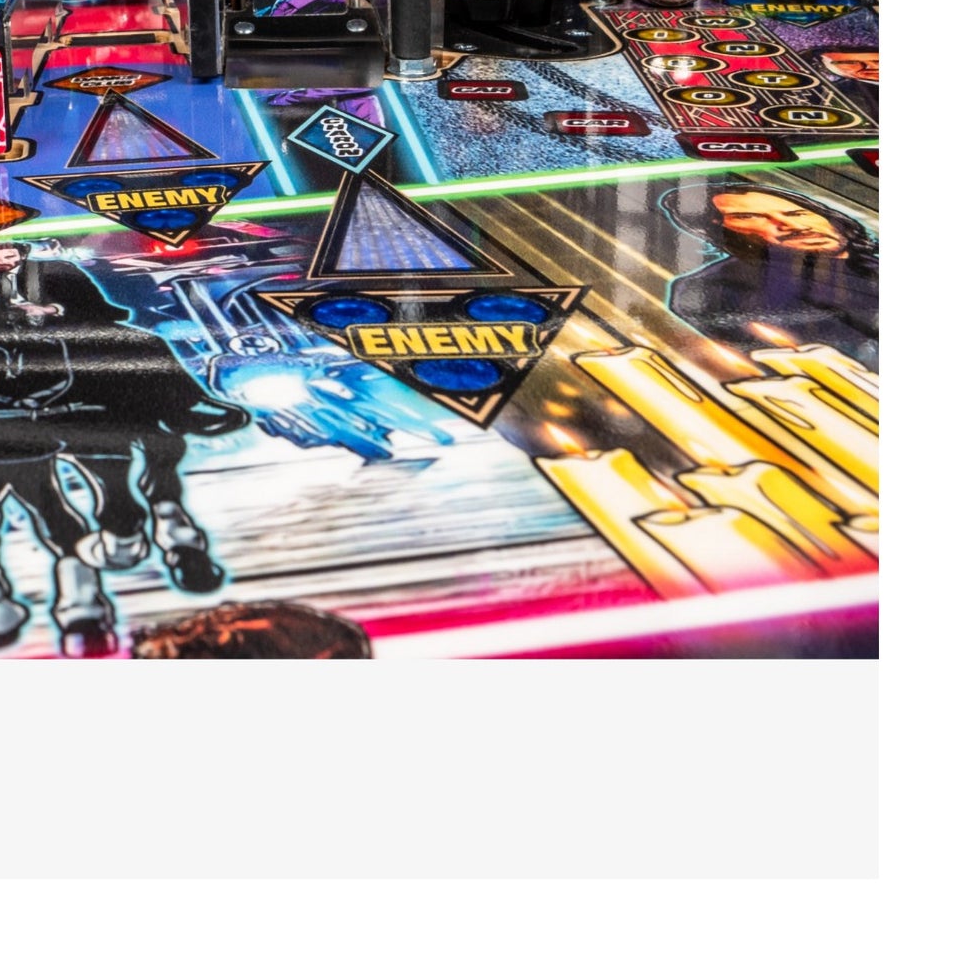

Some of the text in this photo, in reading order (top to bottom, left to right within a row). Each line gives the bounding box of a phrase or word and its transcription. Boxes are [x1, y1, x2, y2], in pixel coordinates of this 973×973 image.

[750, 3, 845, 13] ENEMY
[694, 18, 735, 26] W
[726, 43, 759, 53] N
[757, 74, 787, 84] T
[451, 86, 512, 94] CAR
[789, 110, 828, 121] N
[562, 118, 630, 127] CAR
[320, 117, 364, 158] CHARON
[697, 142, 772, 153] CAR
[95, 187, 219, 211] ENEMY
[358, 325, 528, 355] ENEMY
